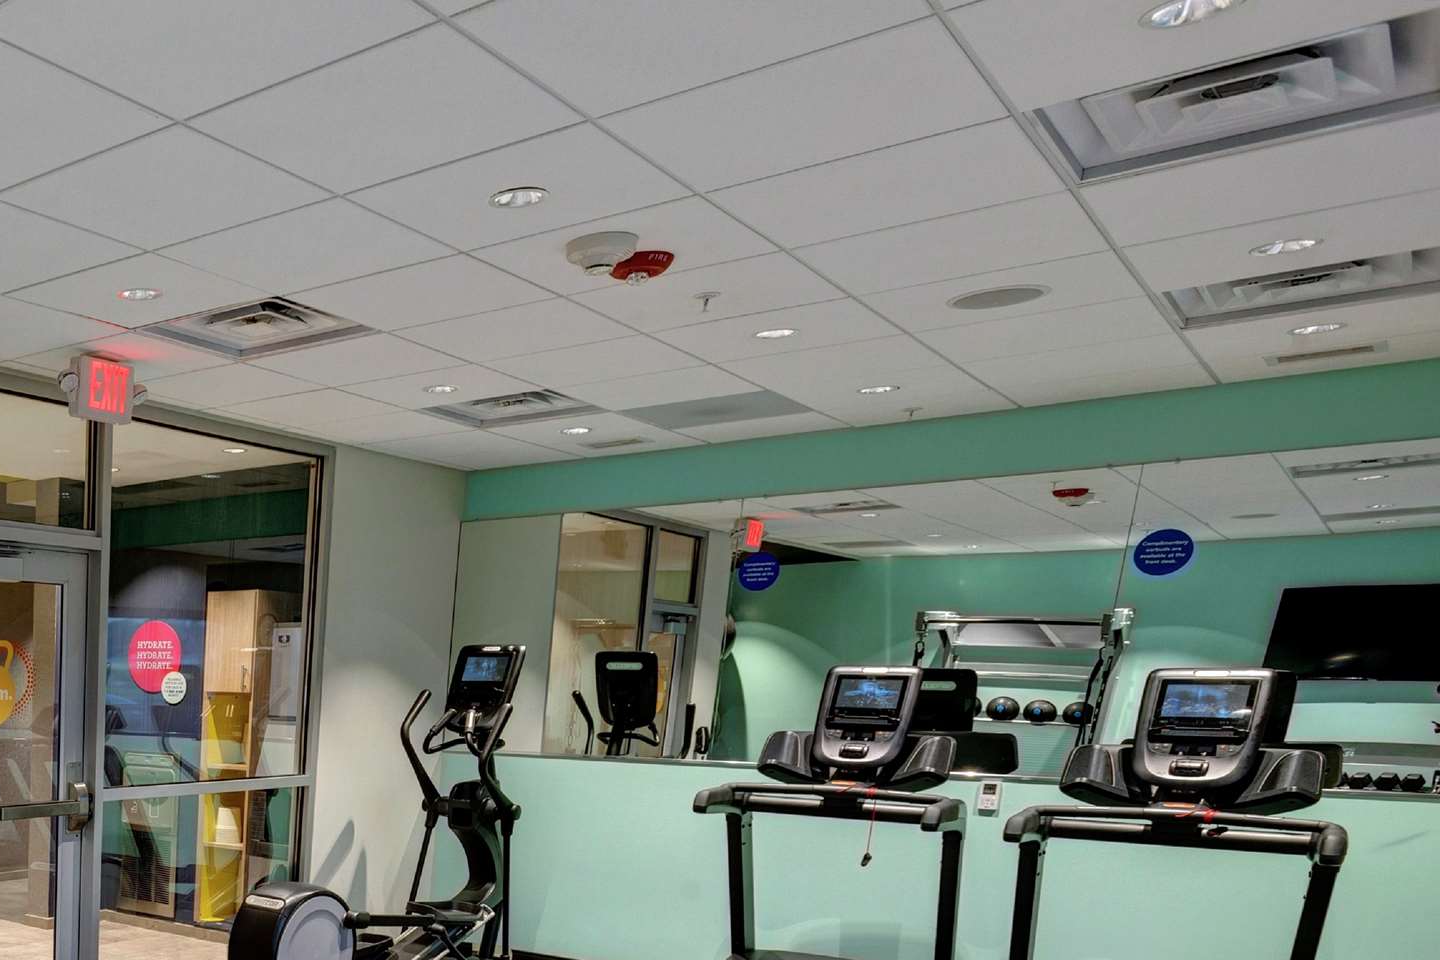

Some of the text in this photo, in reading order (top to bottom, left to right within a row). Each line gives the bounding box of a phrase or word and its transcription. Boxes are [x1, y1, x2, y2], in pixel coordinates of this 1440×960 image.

[648, 253, 668, 261] FIRE
[88, 360, 130, 416] EXIT
[137, 641, 174, 649] HYDRATE.
[136, 651, 174, 660] HYDRATE.
[136, 662, 174, 670] HYDRATE.
